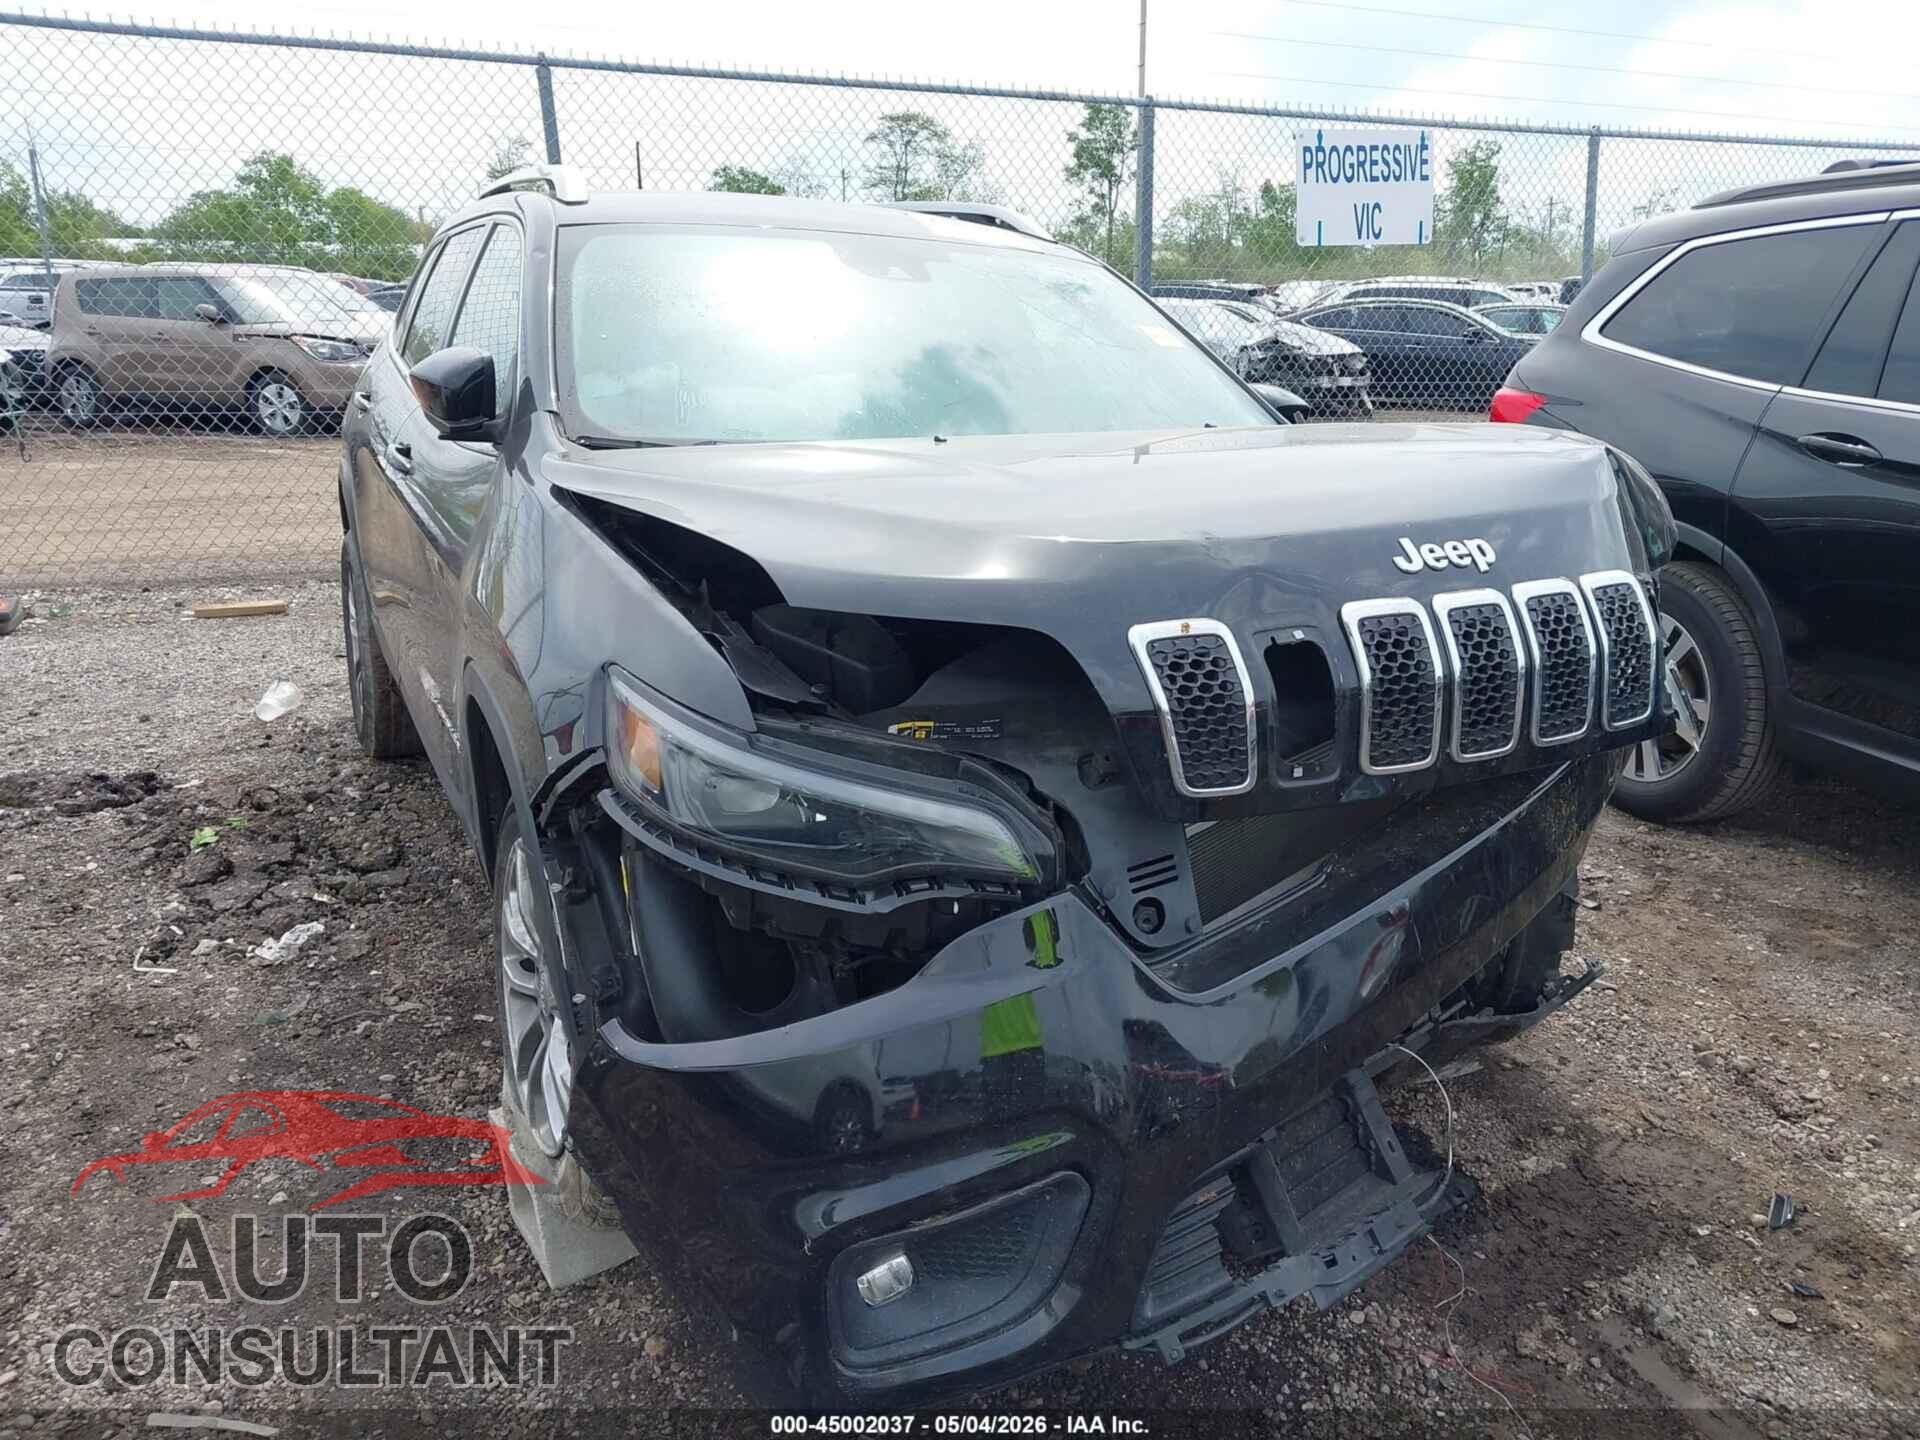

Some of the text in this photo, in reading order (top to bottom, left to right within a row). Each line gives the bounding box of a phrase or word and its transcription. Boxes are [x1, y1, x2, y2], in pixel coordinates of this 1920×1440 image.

[1303, 144, 1429, 183] PROGRESSIVE
[1353, 202, 1383, 240] VIC
[1392, 537, 1497, 574] Jeep
